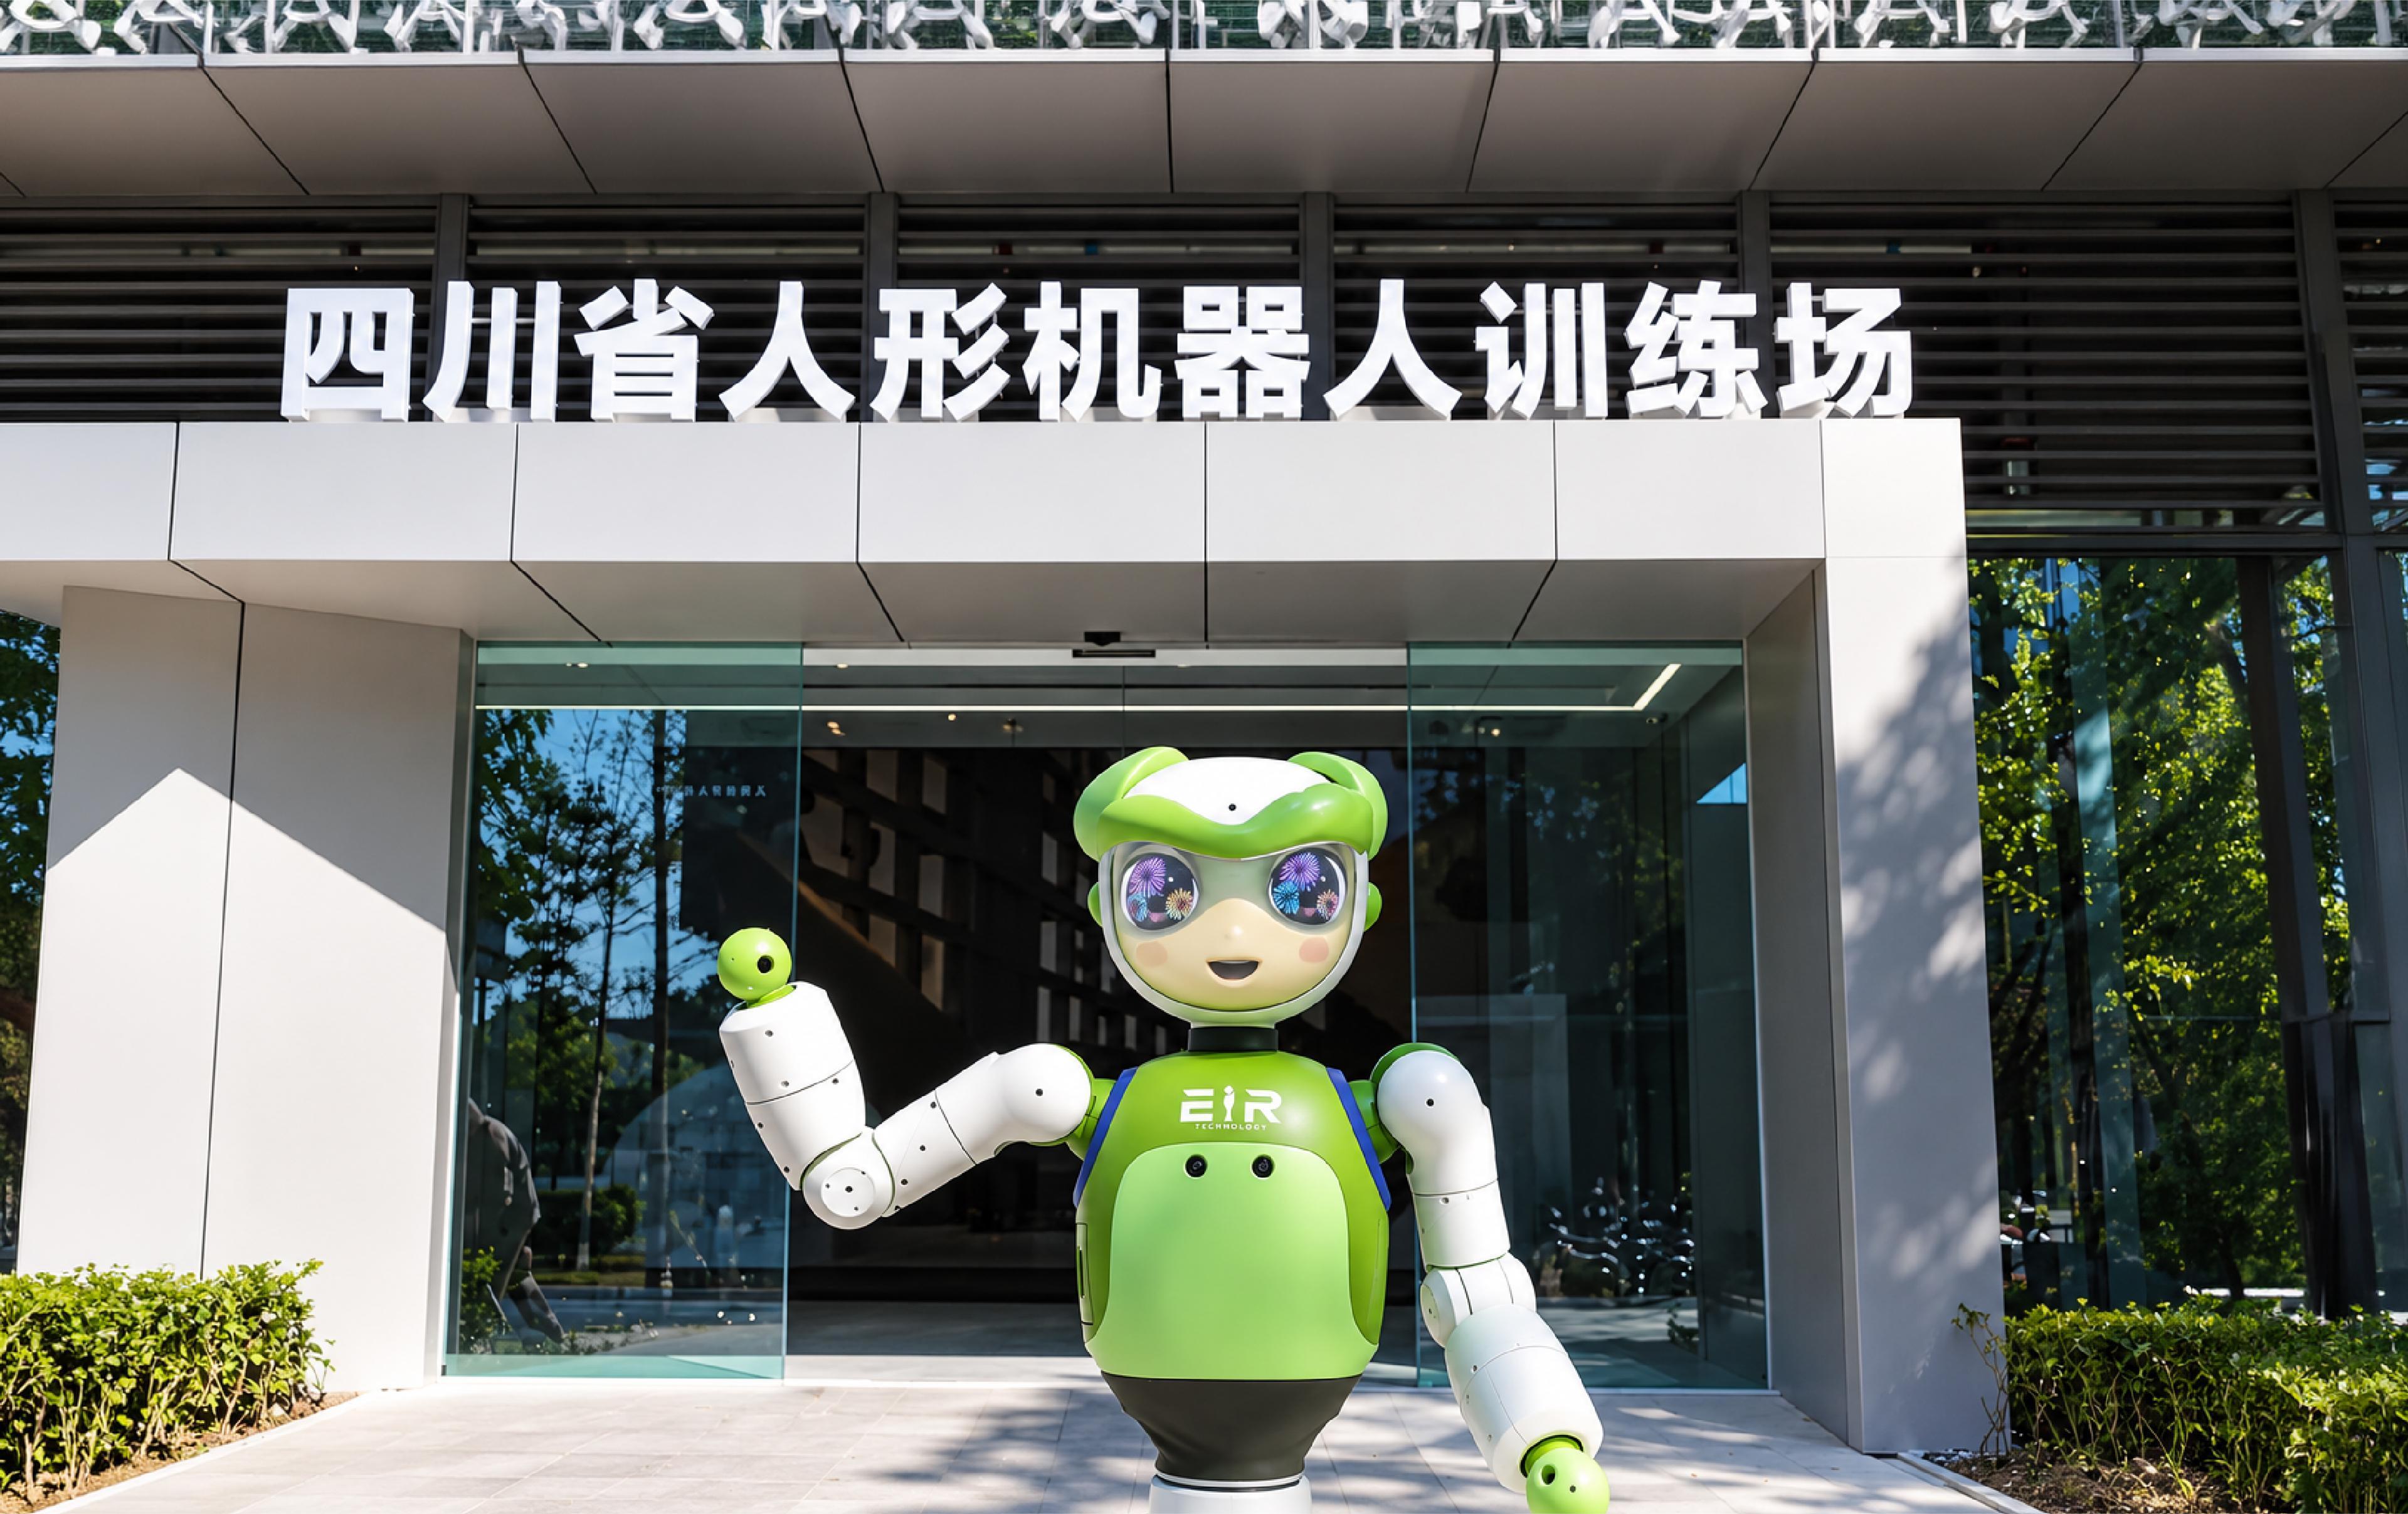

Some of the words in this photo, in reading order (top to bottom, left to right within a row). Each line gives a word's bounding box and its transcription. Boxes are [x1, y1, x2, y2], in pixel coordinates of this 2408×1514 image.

[281, 278, 1911, 421] 四川省人形机器人训练场
